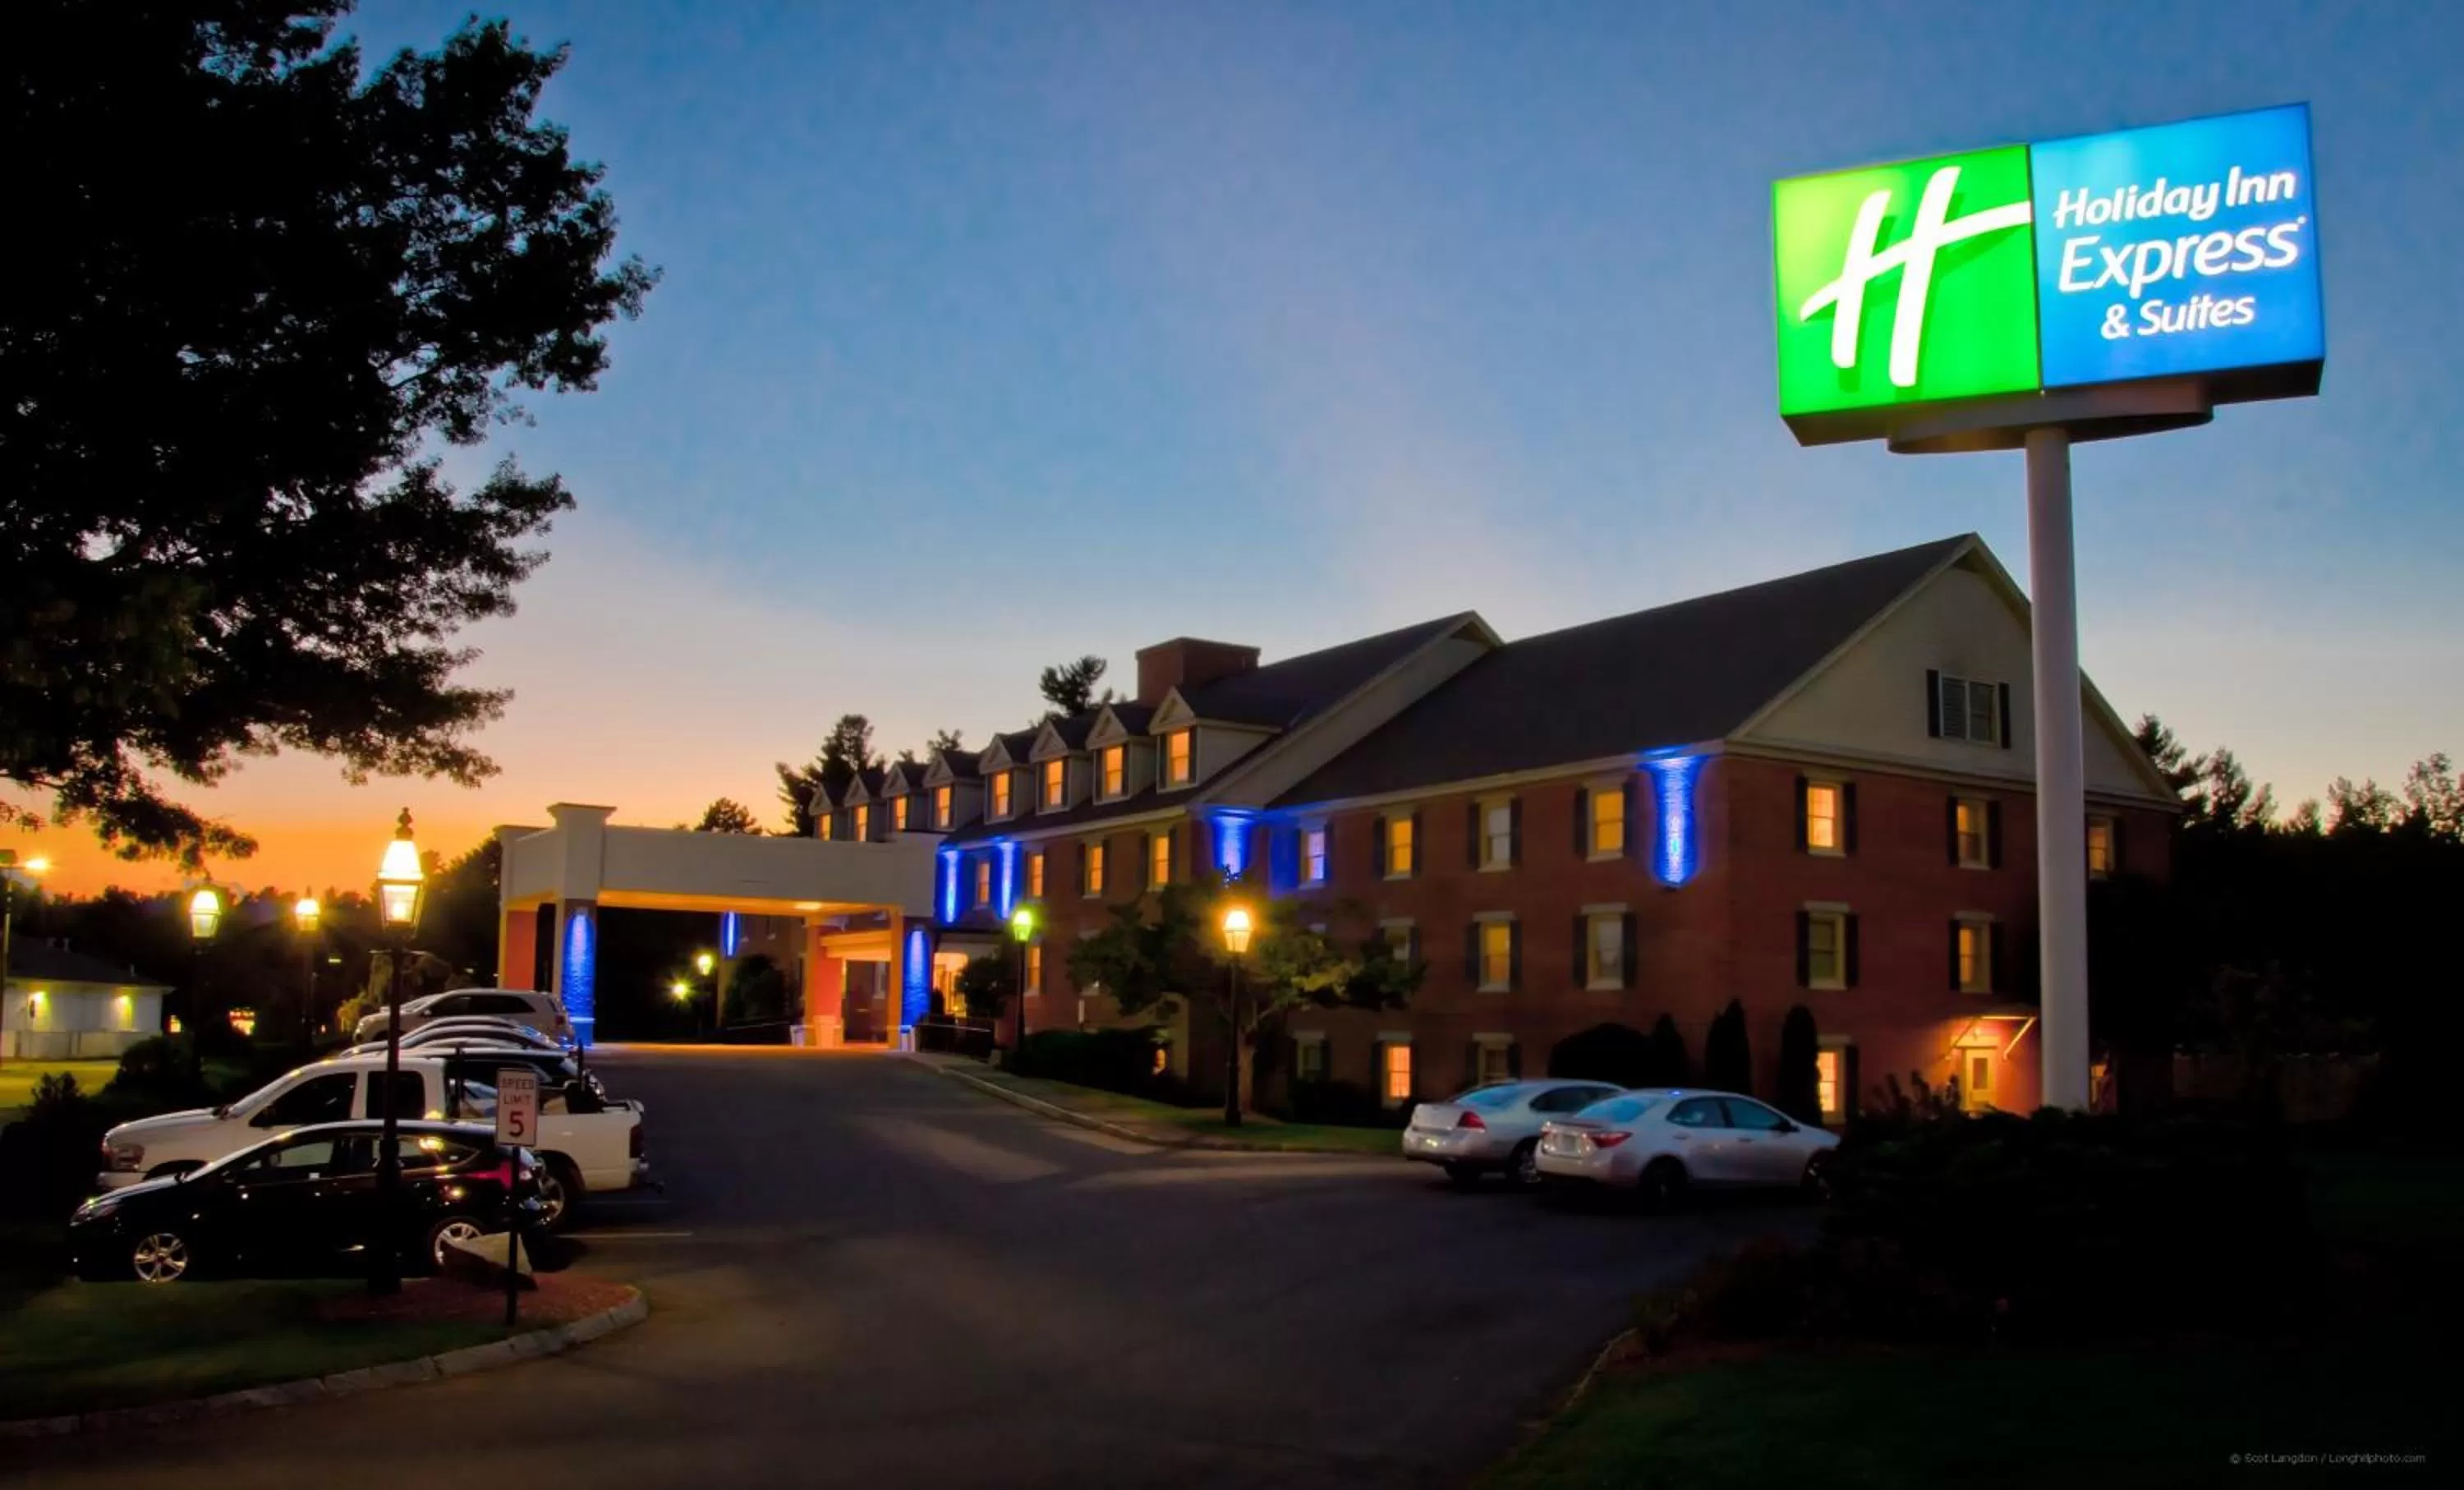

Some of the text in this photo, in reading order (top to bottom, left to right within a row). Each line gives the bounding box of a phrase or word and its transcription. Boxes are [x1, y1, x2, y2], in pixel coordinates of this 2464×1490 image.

[2053, 166, 2296, 229] Holiday Inn
[2058, 221, 2301, 299] Express
[2100, 294, 2256, 340] & Suites
[499, 1077, 534, 1090] SPEED
[503, 1092, 531, 1105] LIMIT
[508, 1111, 525, 1137] 5
